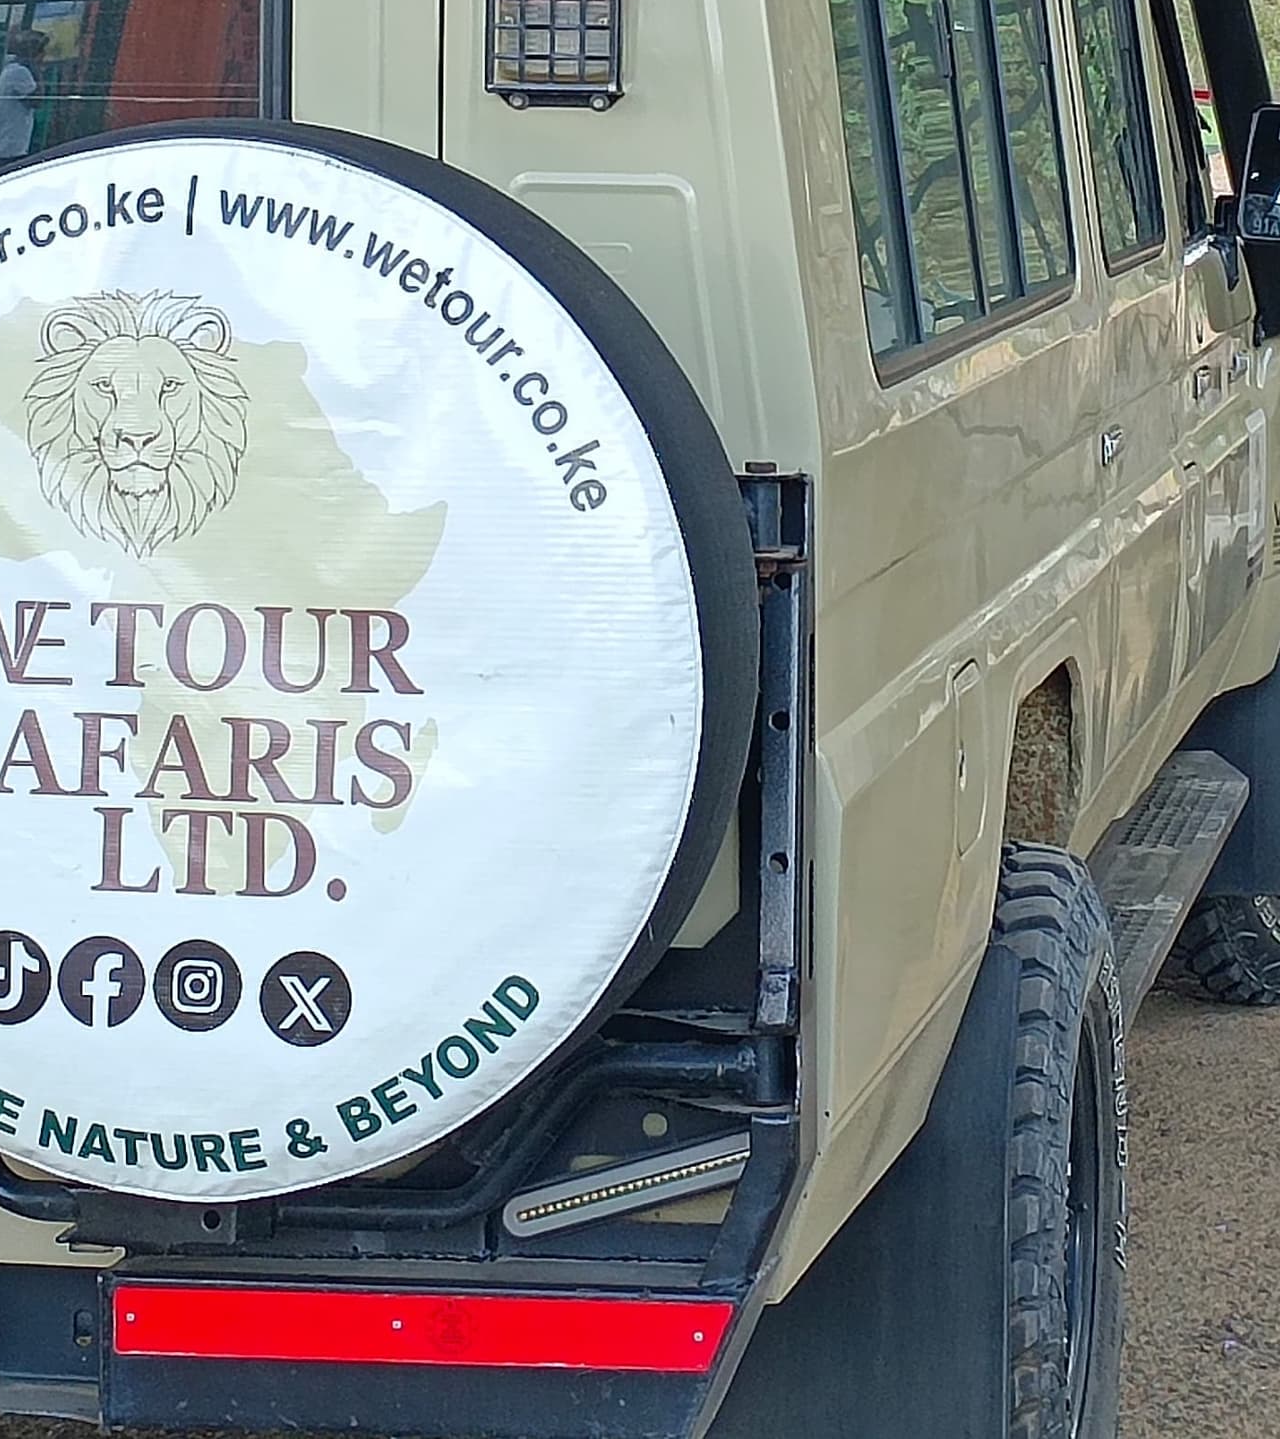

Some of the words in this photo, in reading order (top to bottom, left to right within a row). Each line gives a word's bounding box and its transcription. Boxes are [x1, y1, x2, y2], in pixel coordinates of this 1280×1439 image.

[219, 188, 607, 513] www.wetour.co.ke
[90, 602, 424, 695] TOUR
[90, 806, 348, 904] LTD.
[38, 1108, 268, 1173] NATURE
[286, 1117, 328, 1162] &
[336, 973, 541, 1144] BEYOND
